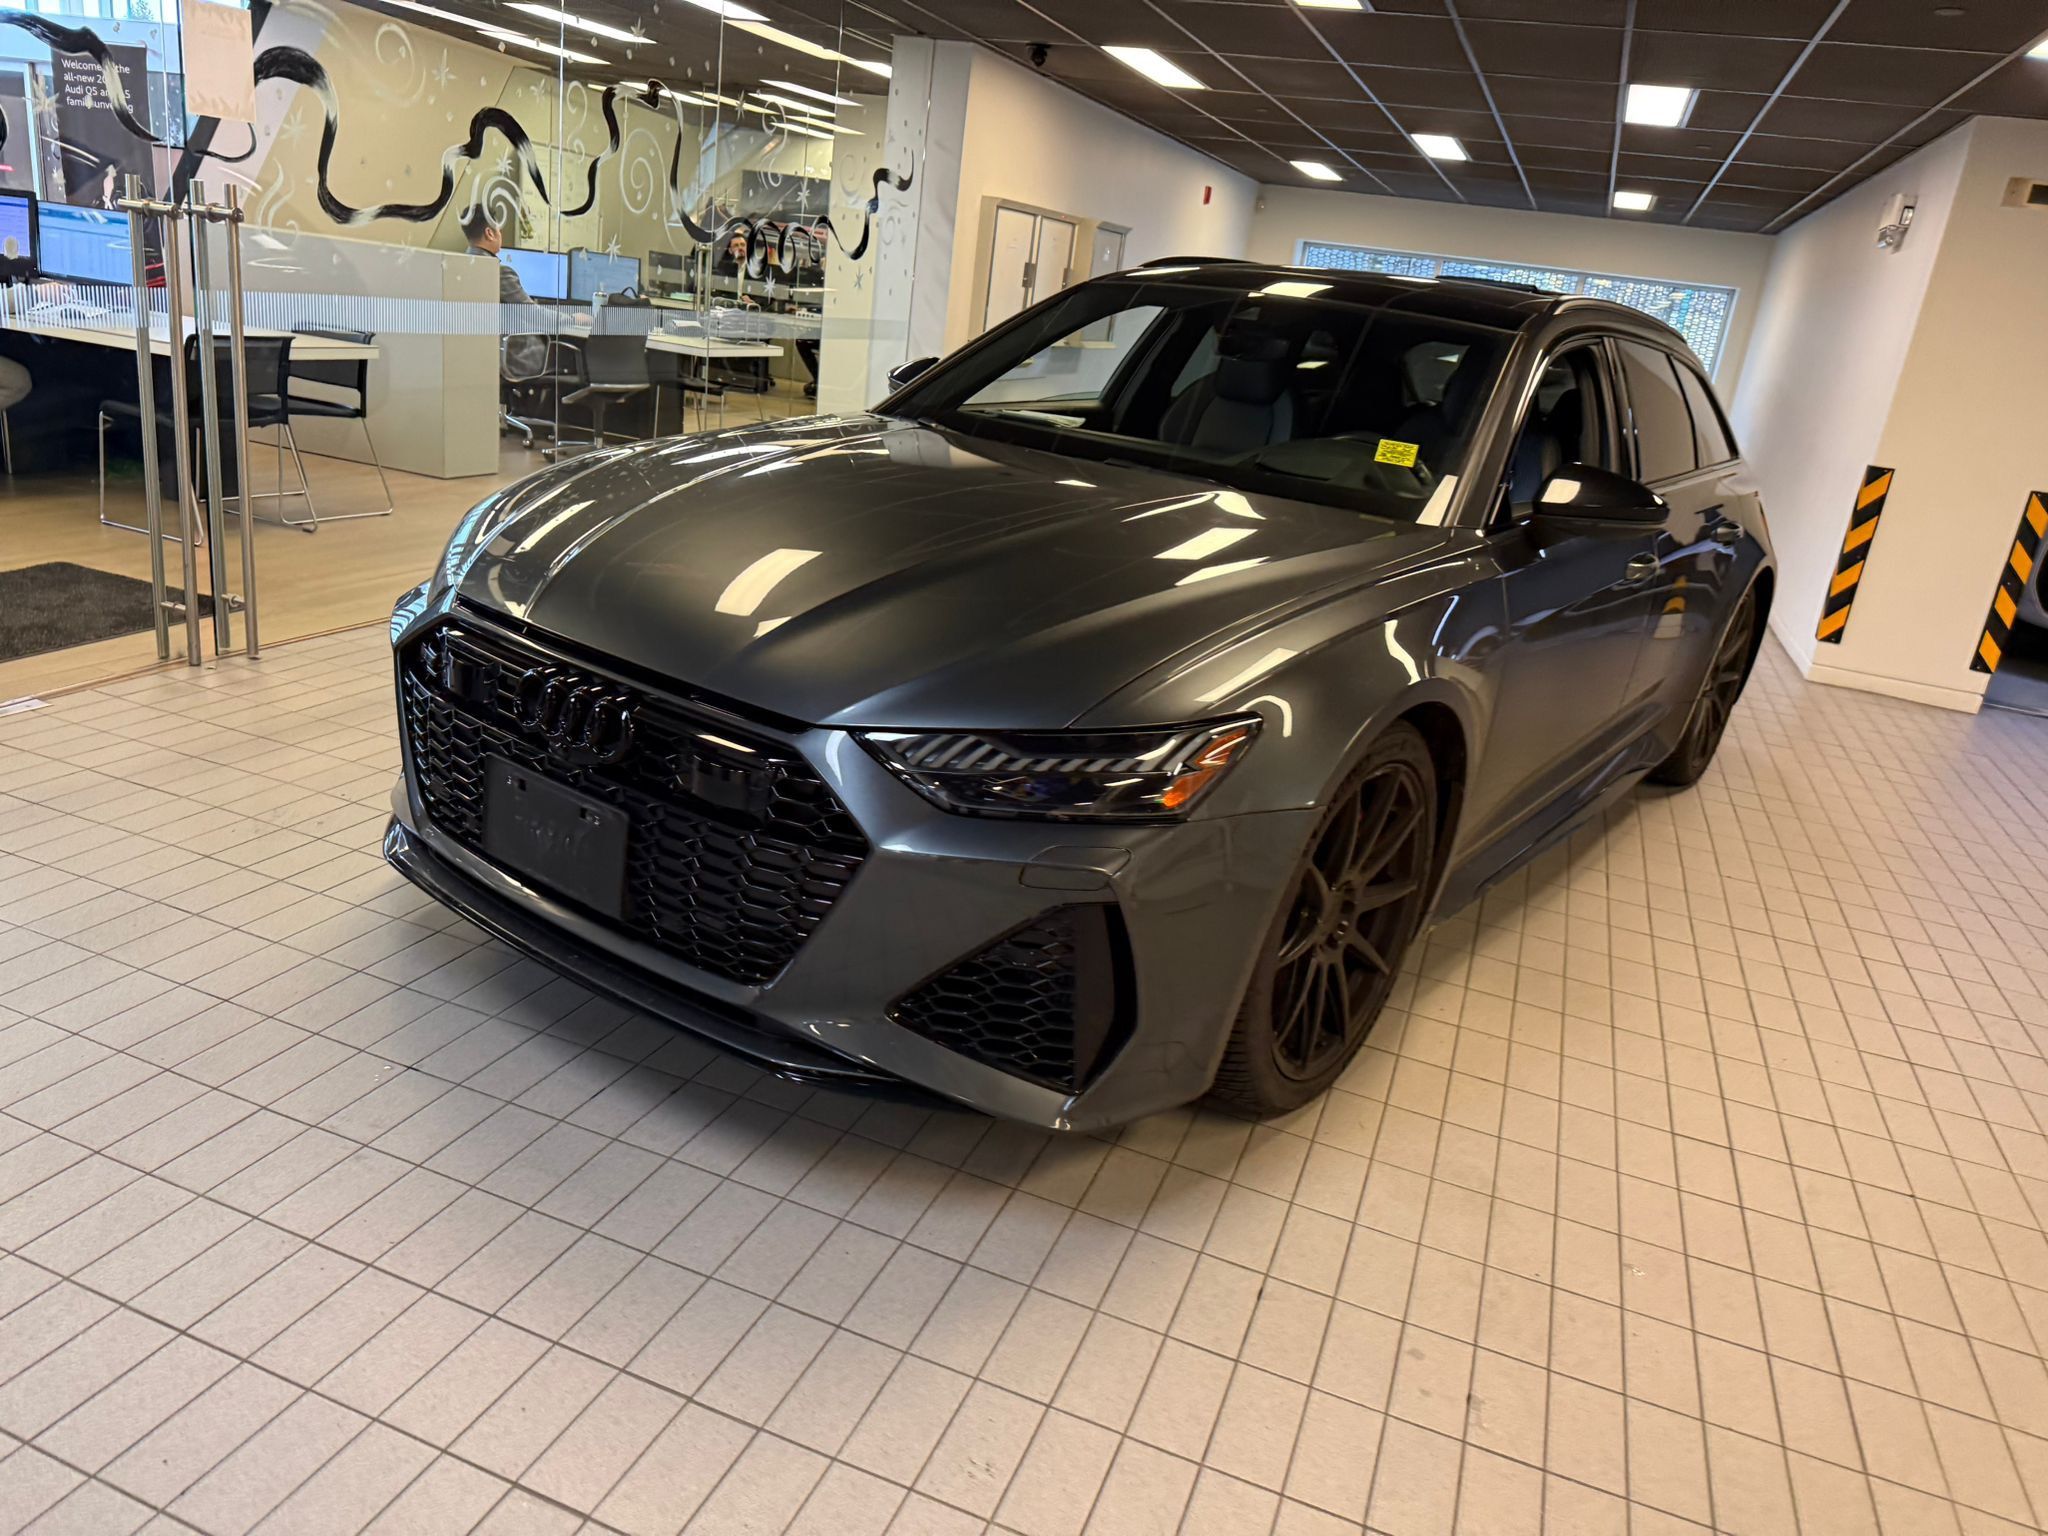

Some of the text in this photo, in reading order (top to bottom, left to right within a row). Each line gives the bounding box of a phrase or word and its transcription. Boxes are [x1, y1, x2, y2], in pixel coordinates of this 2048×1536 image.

[61, 58, 103, 71] Welcome
[64, 72, 94, 83] all-new
[65, 84, 83, 94] Audi
[85, 86, 98, 97] Q5
